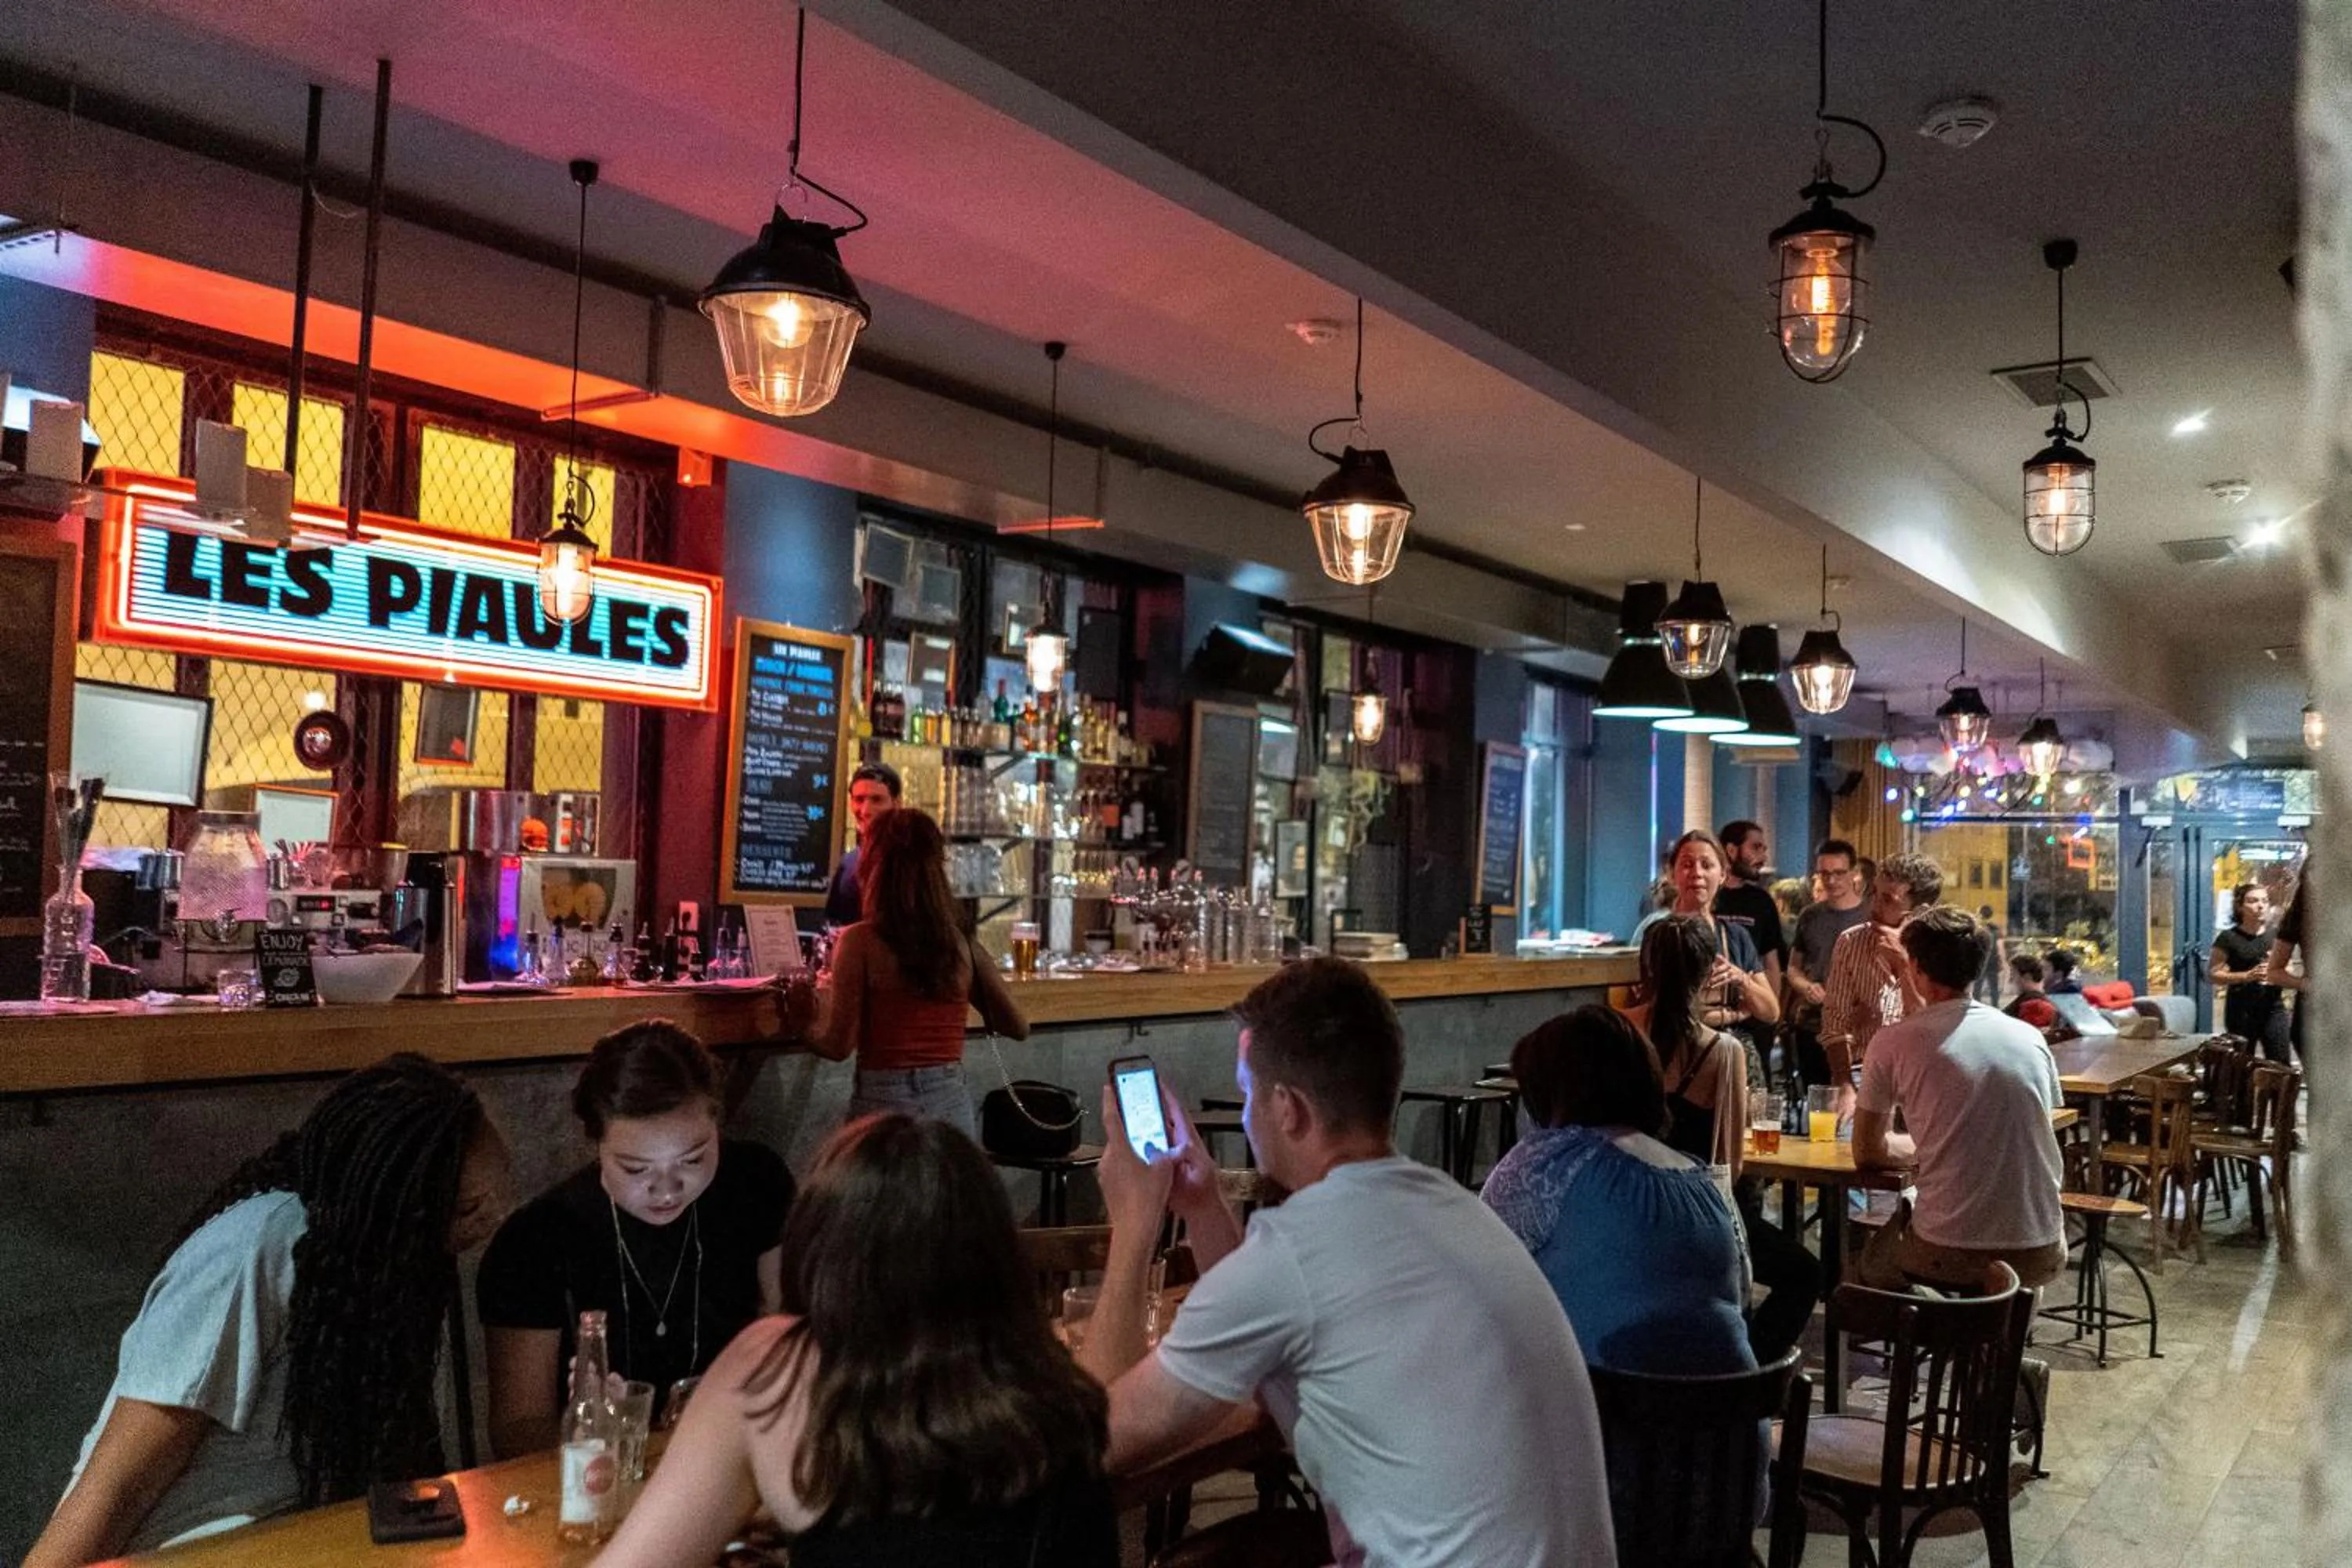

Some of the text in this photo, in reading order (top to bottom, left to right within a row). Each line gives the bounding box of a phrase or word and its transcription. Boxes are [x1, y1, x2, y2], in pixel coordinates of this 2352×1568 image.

[165, 532, 689, 669] LES PIAULES
[260, 934, 304, 950] ENJOY
